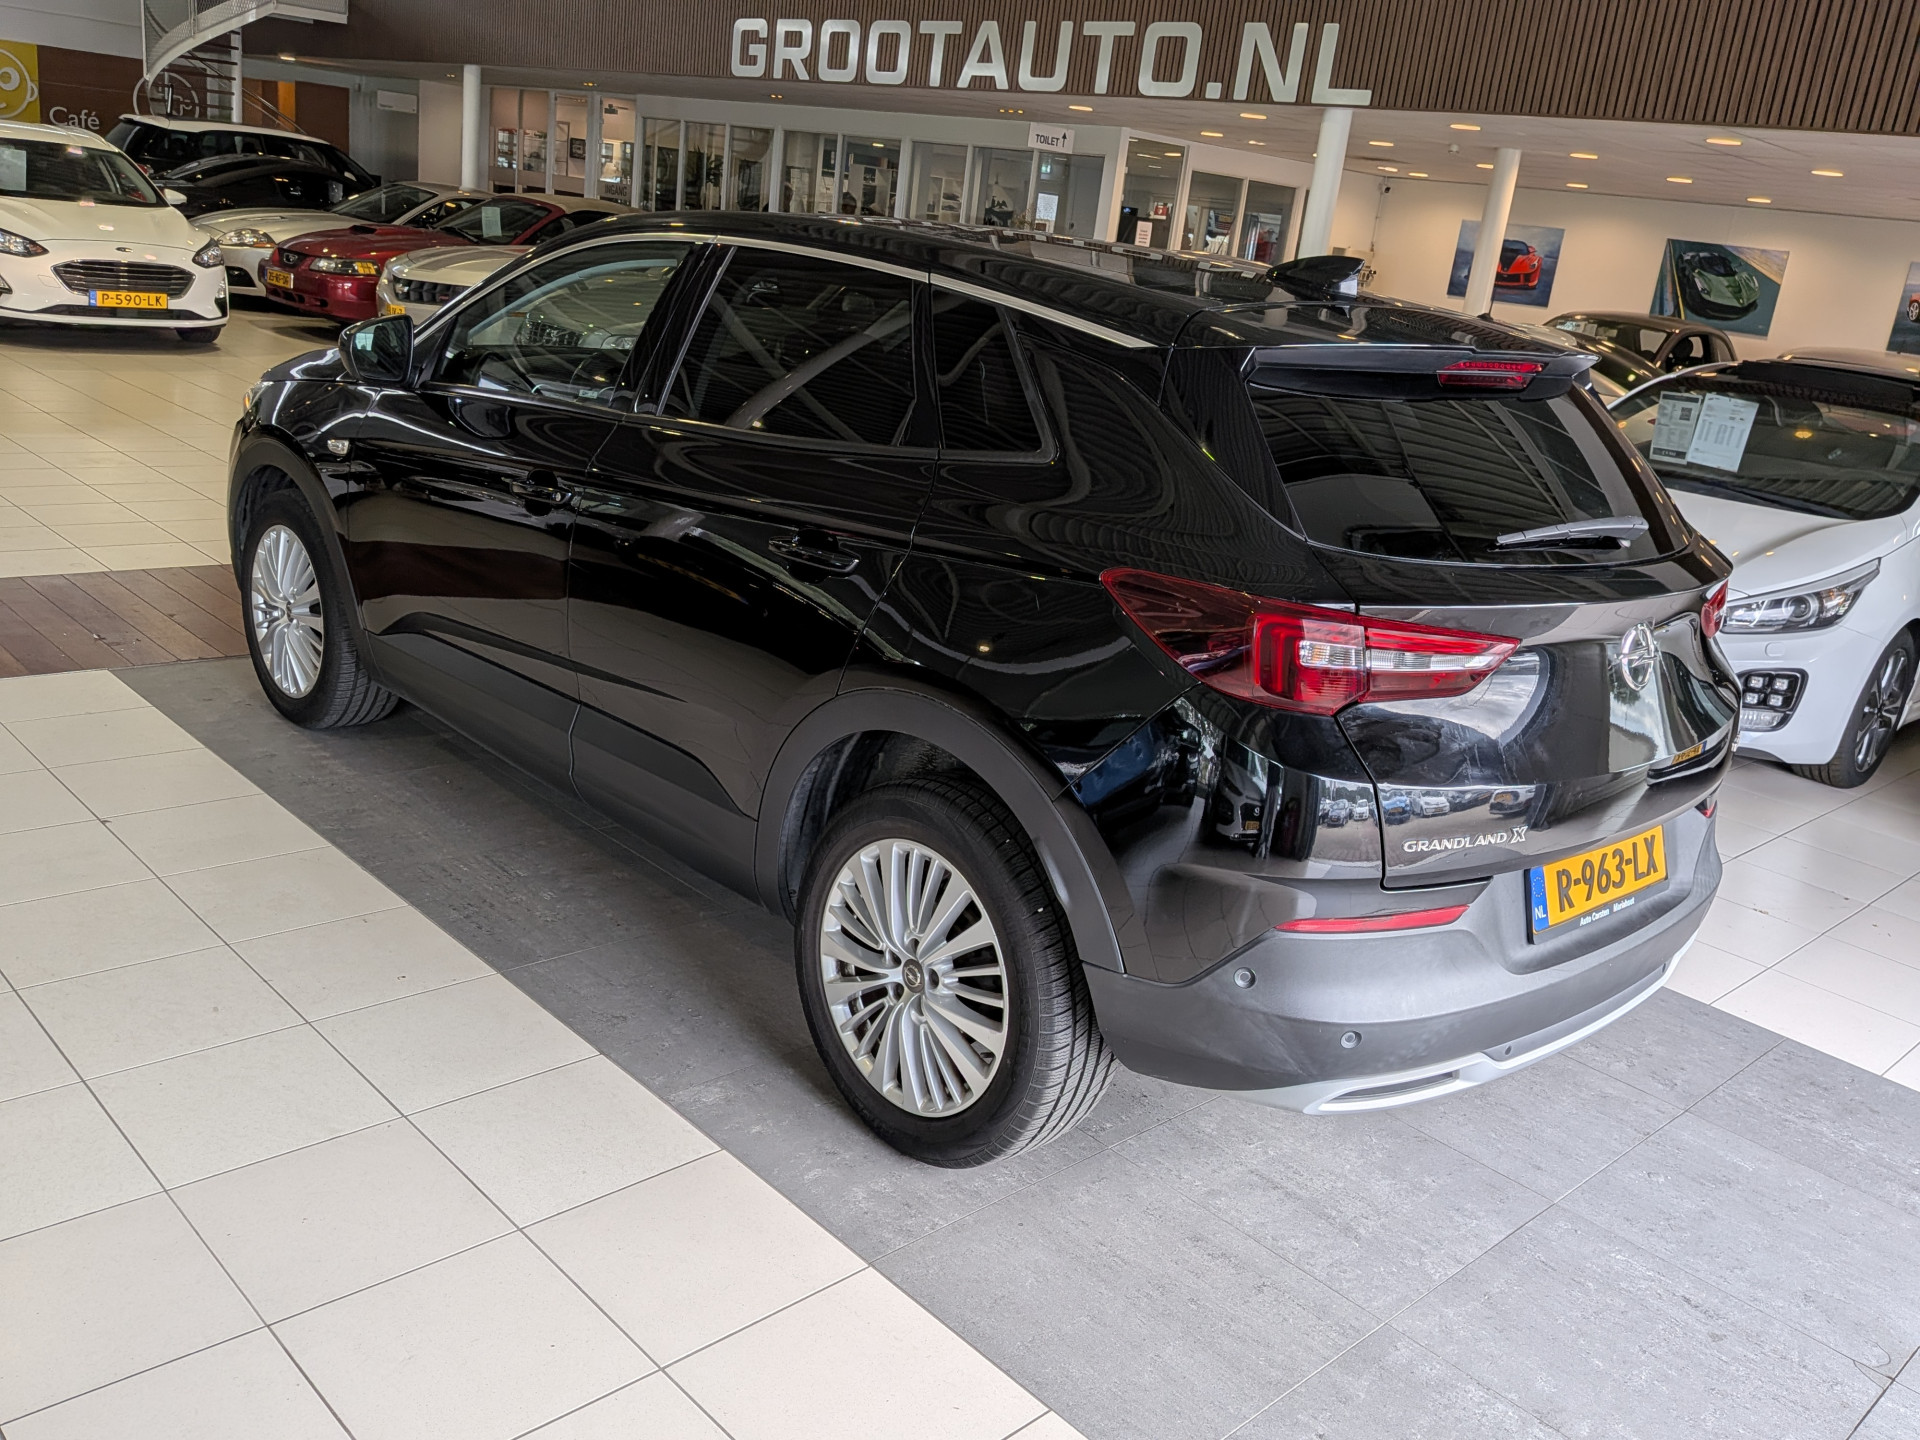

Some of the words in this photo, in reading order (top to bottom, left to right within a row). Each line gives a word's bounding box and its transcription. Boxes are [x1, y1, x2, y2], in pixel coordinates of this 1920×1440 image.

[731, 17, 1372, 106] GROOTAUTO.NL
[49, 106, 100, 130] Café
[1035, 133, 1060, 147] TOILET
[604, 183, 627, 197] INGANG
[101, 293, 163, 307] P-590-LK
[1402, 832, 1508, 852] GRANDLAND
[1509, 825, 1528, 844] X
[1556, 834, 1659, 913] R-963-LX
[1534, 904, 1547, 920] NL
[1579, 915, 1592, 927] Auto
